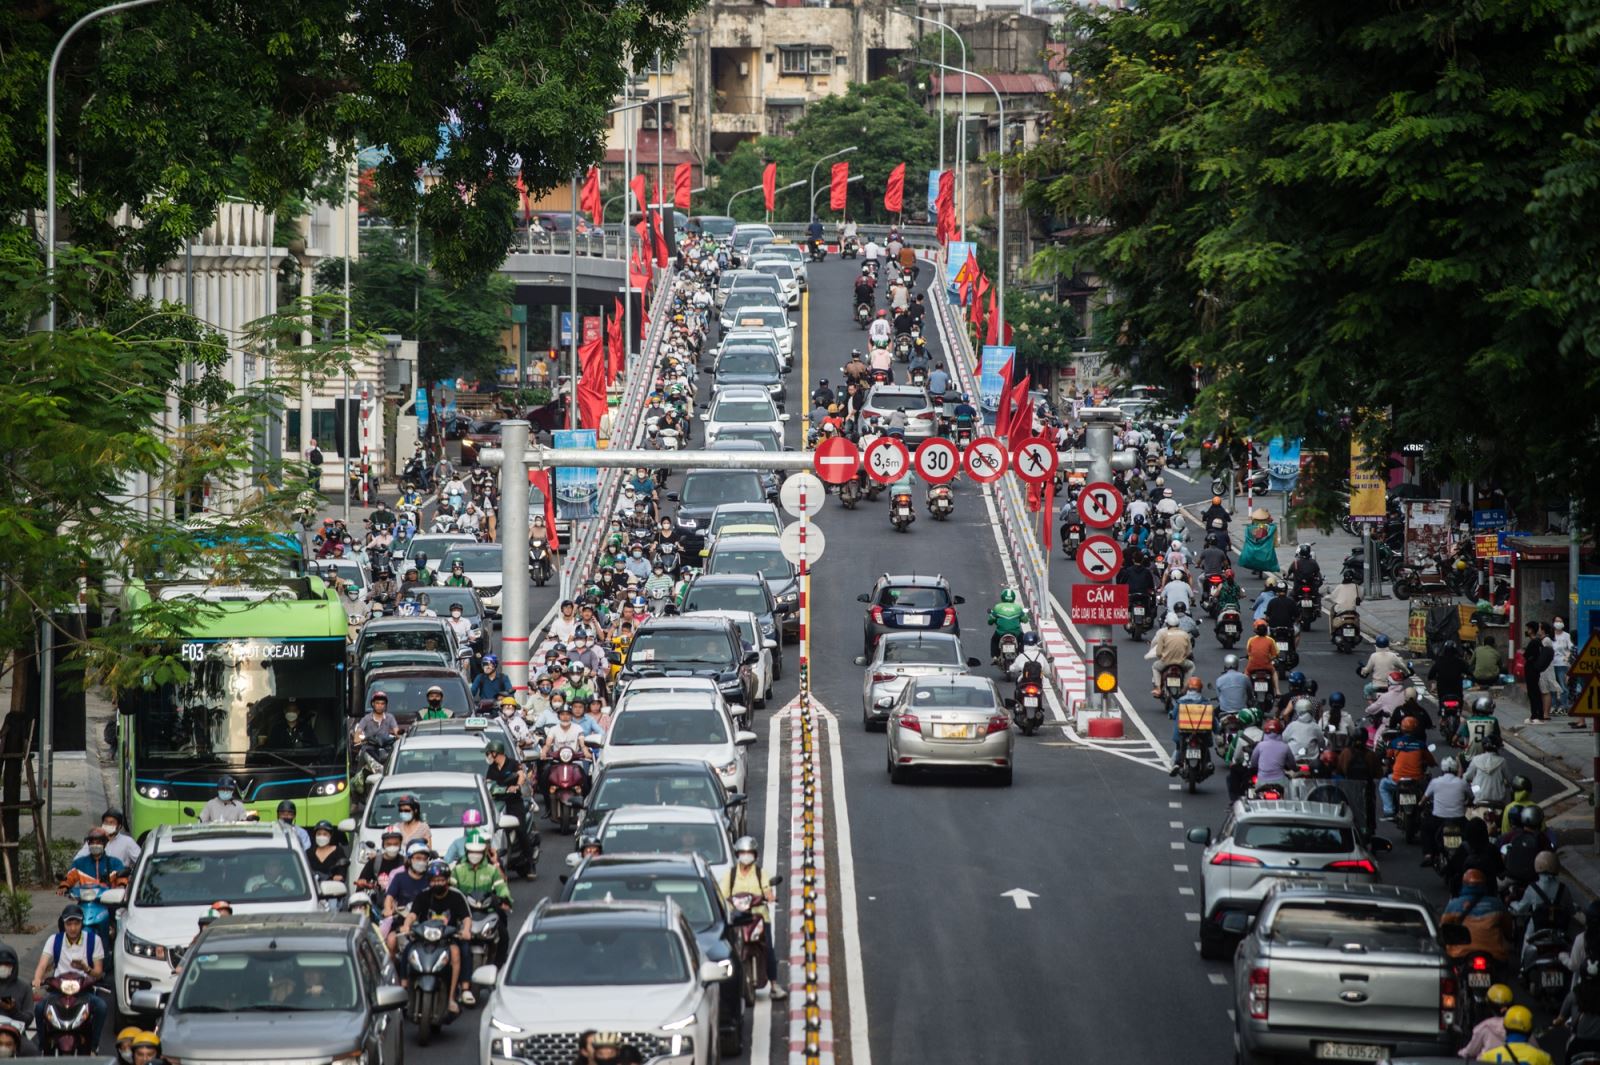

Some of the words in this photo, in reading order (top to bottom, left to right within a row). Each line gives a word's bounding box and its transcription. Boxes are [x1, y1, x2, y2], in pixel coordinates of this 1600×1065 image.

[874, 453, 899, 469] 3,5m
[927, 451, 948, 470] 30
[1087, 586, 1114, 603] CẤM
[1072, 605, 1081, 619] CÁC
[1081, 607, 1090, 620] LOẠI
[1091, 607, 1097, 619] XE
[1106, 607, 1112, 619] XE
[262, 644, 298, 658] OCEAN
[1474, 725, 1485, 743] 9
